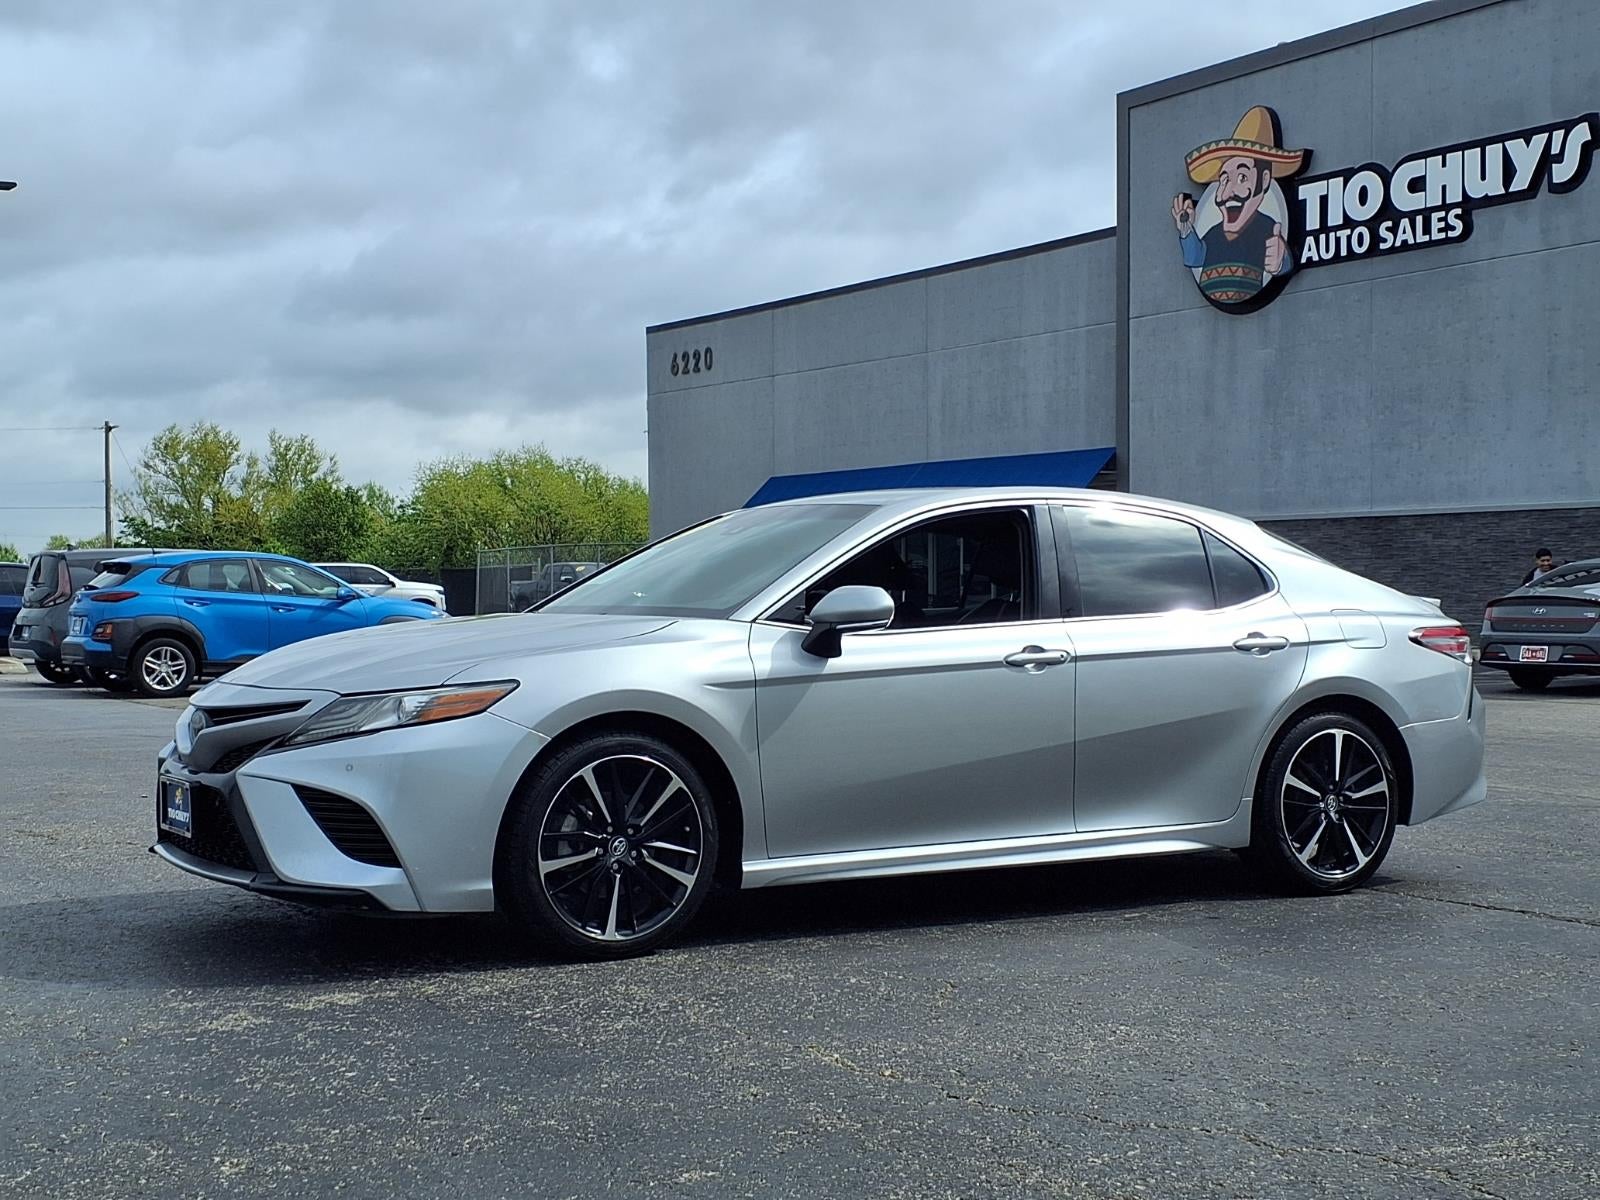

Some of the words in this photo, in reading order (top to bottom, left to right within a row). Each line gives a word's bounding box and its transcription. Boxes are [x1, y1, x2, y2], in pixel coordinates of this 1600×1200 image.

[1298, 171, 1384, 231] TIO
[1389, 122, 1591, 211] CHUY'S
[1300, 225, 1370, 263] AUTO
[1379, 208, 1463, 250] SALES
[671, 346, 713, 377] 6220
